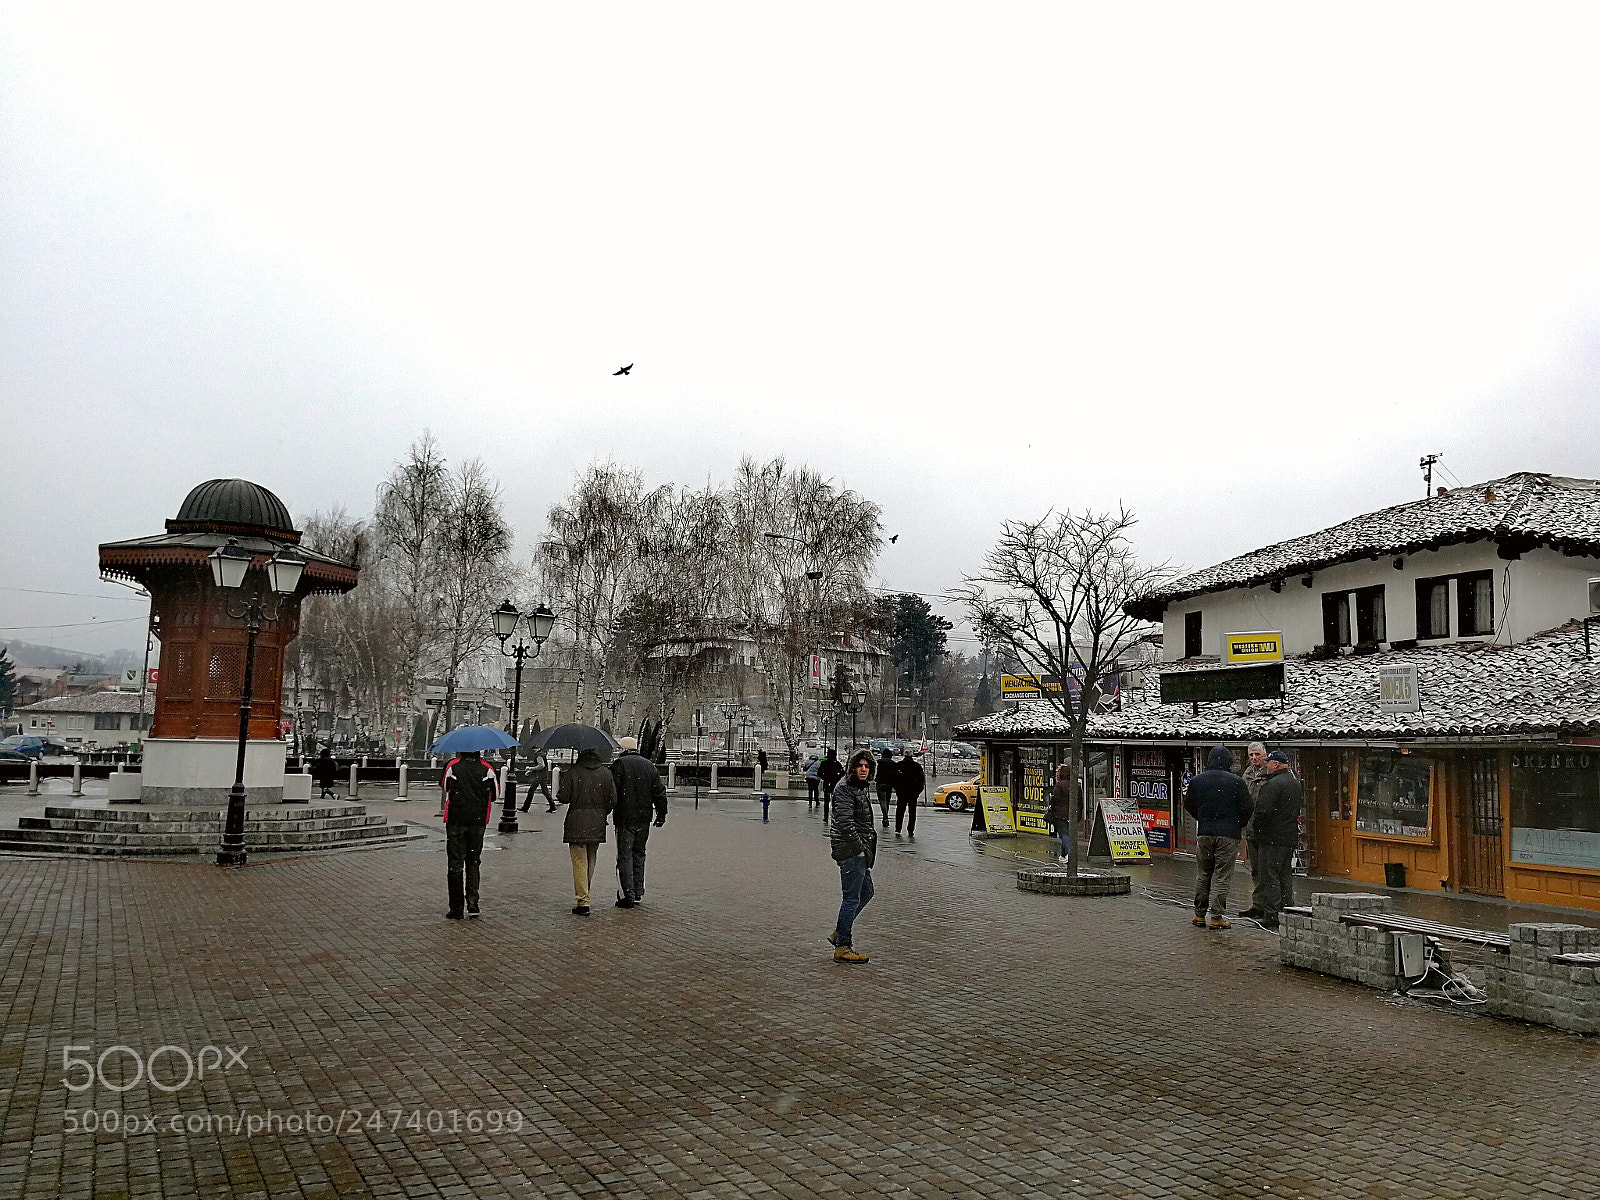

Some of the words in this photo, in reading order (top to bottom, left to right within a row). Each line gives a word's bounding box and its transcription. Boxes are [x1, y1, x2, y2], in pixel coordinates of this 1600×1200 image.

[1024, 768, 1044, 776] TRANSFER
[1024, 787, 1044, 801] OVDE
[1130, 780, 1168, 799] DOLAR
[1116, 826, 1143, 836] DOLAR
